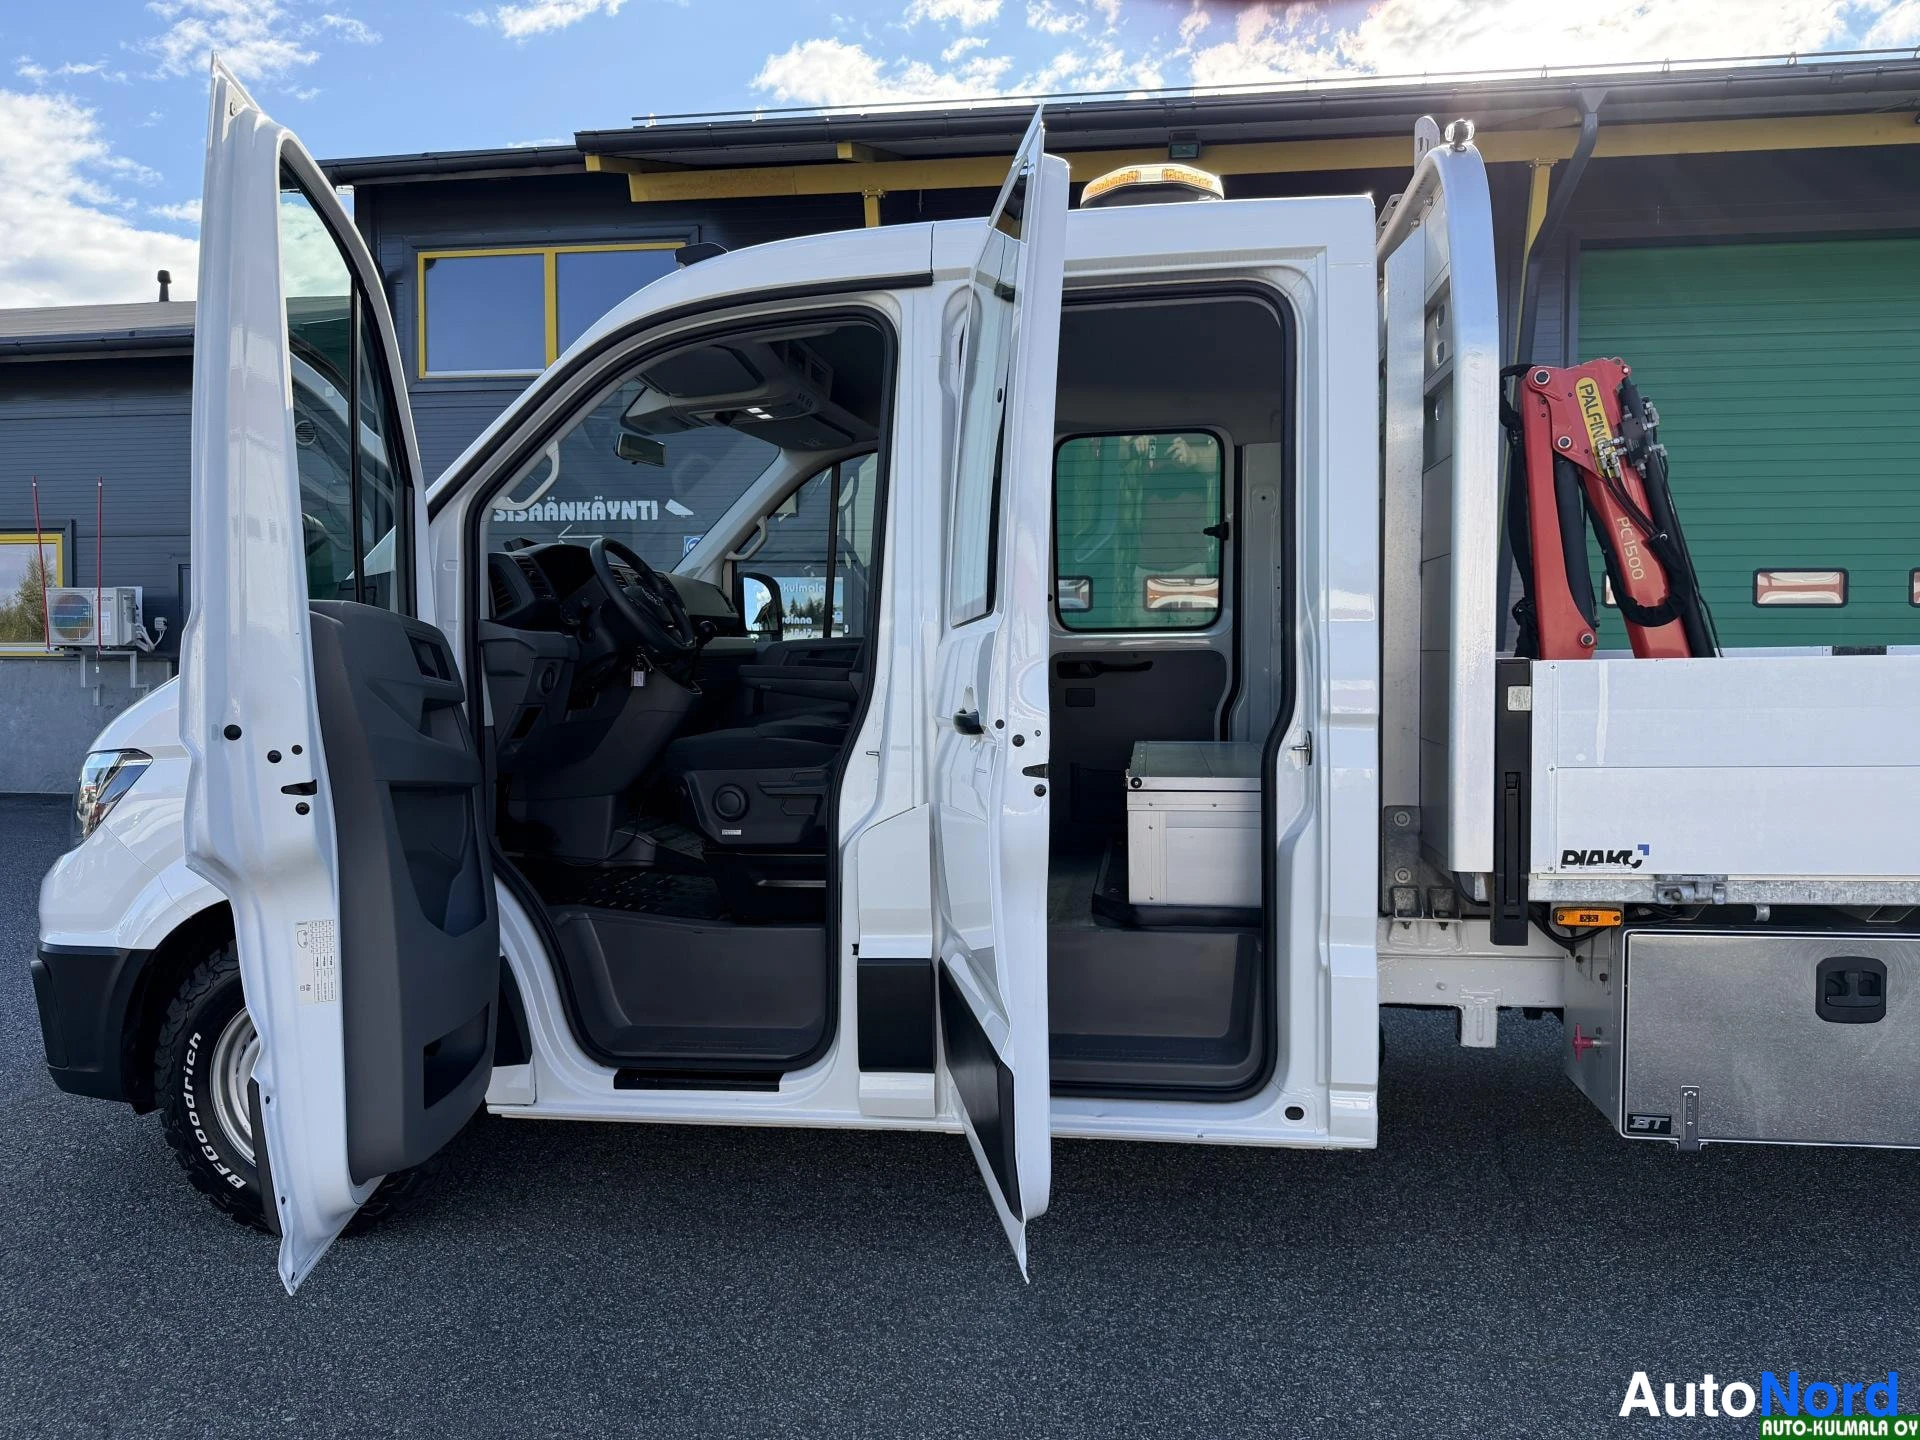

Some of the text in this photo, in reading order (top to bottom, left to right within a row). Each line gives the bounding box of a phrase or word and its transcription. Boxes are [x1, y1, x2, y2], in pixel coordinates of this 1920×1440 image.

[1578, 383, 1609, 447] PALFIN
[1616, 516, 1645, 580] PC 1500
[183, 1032, 247, 1189] BFGoodrich
[1629, 1115, 1670, 1130] BT
